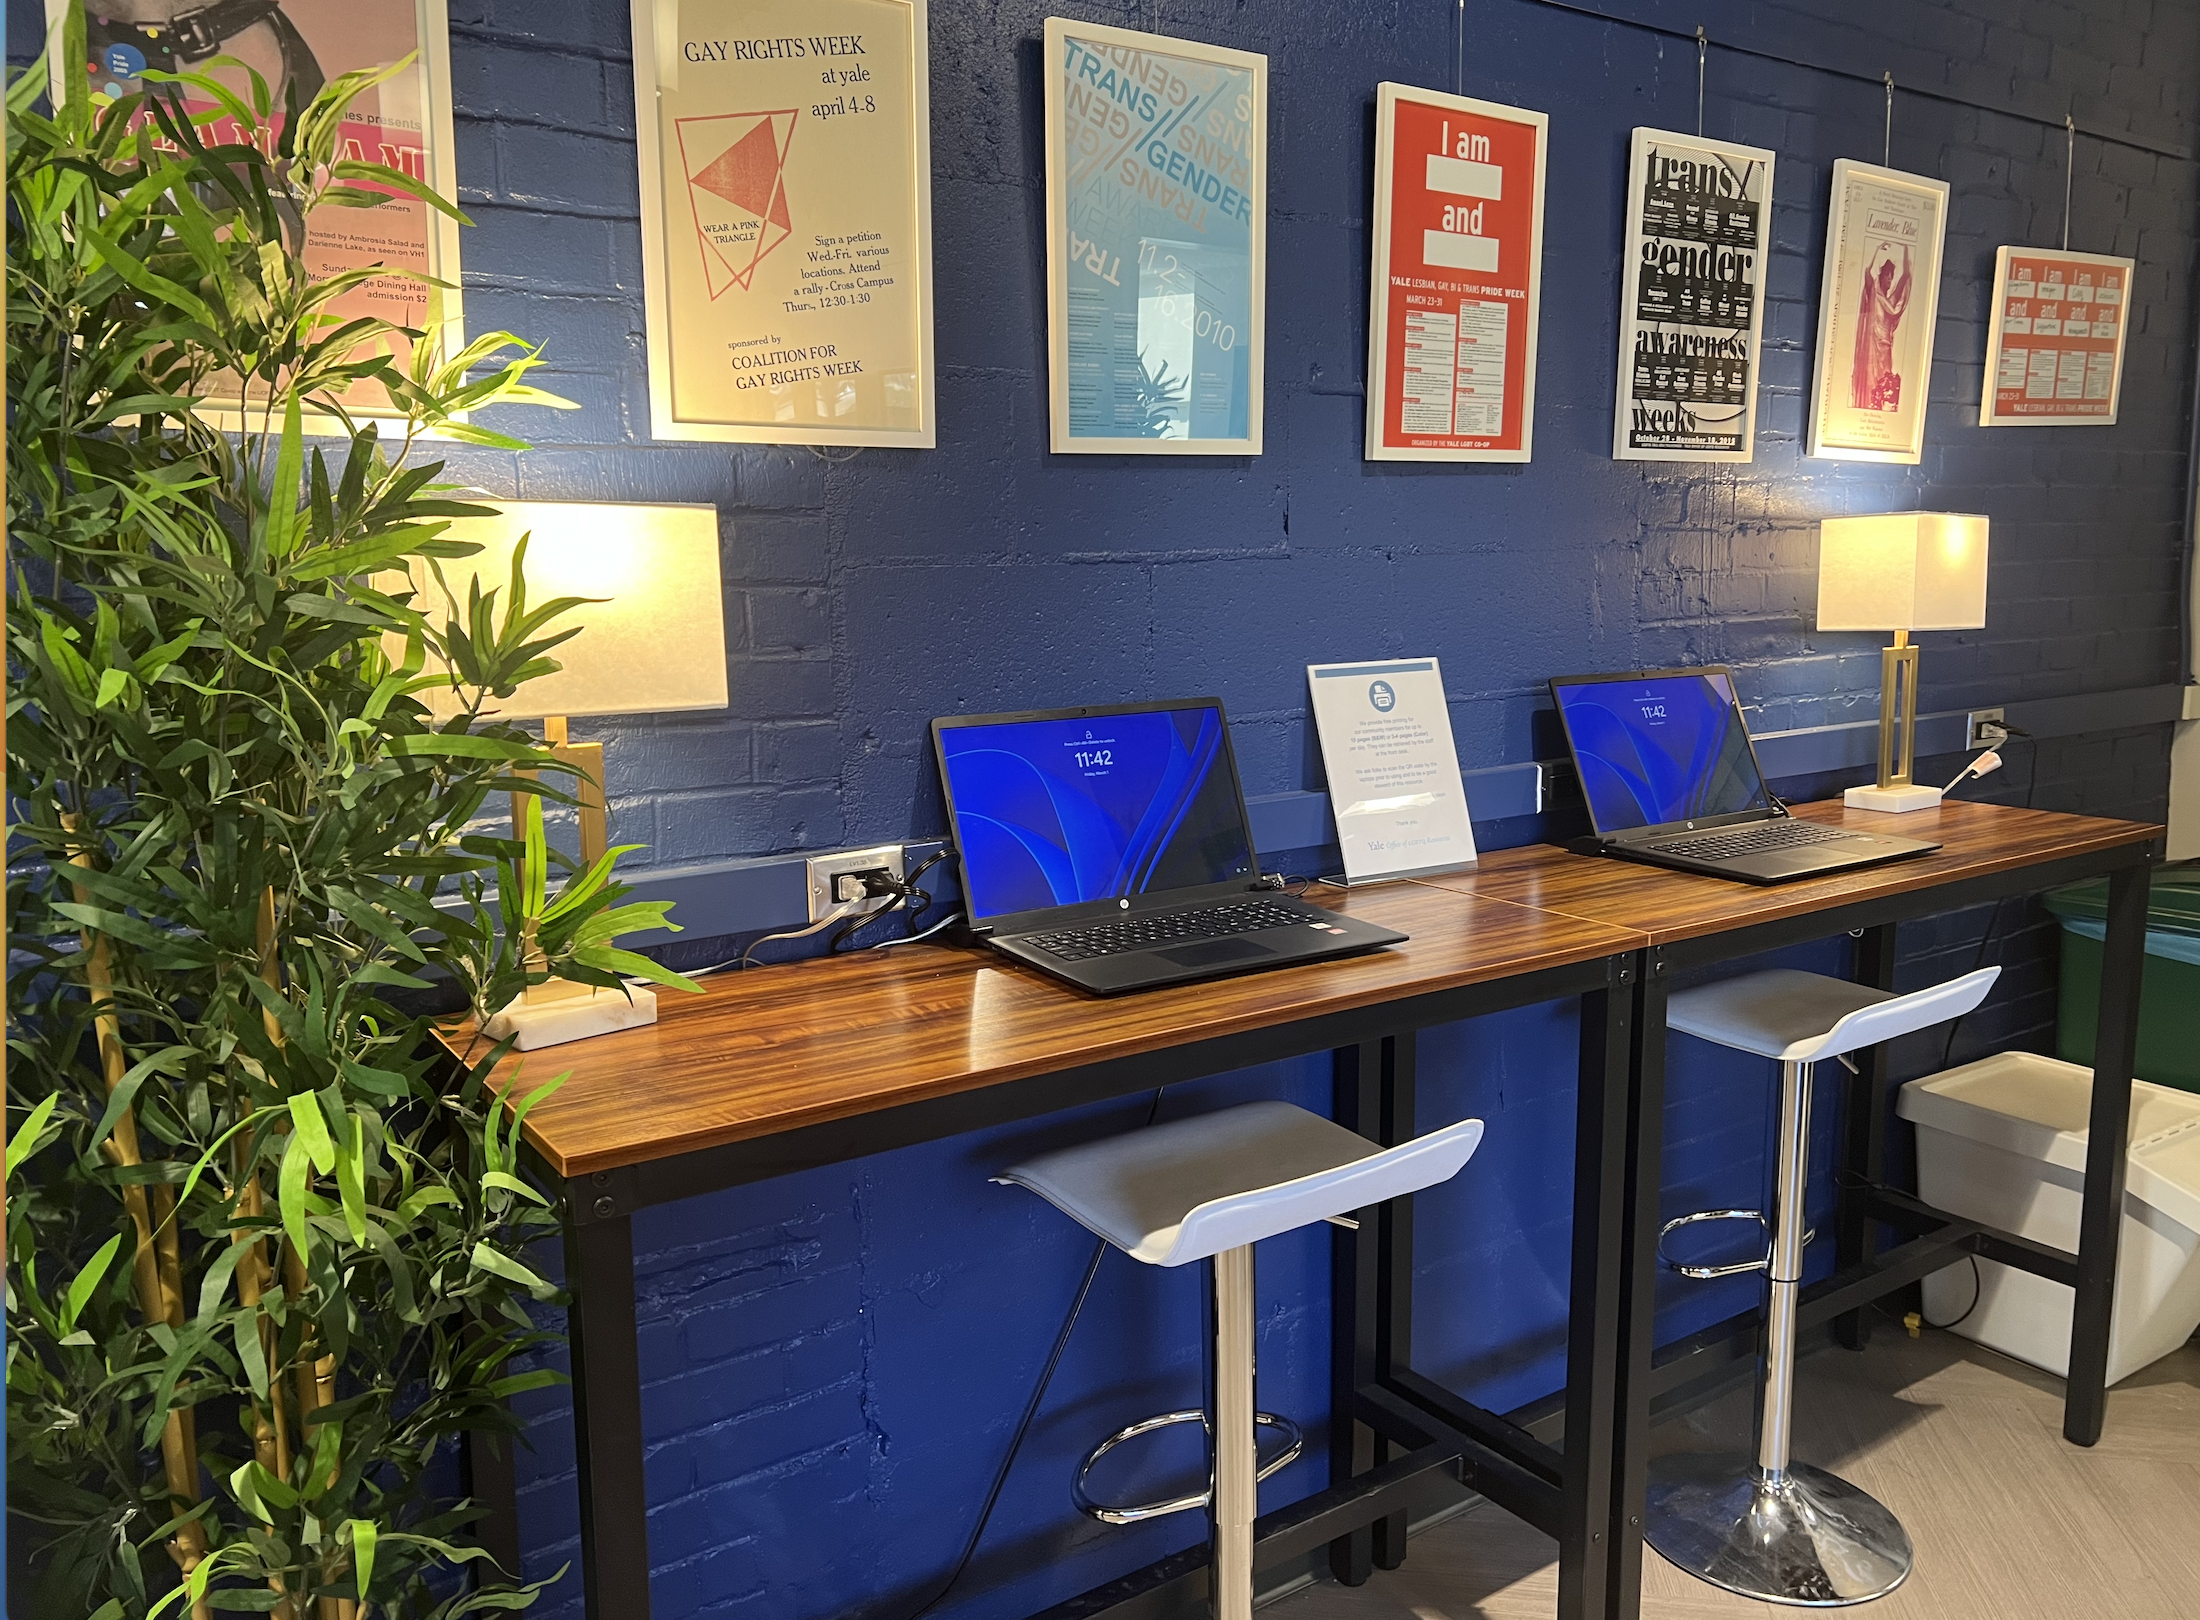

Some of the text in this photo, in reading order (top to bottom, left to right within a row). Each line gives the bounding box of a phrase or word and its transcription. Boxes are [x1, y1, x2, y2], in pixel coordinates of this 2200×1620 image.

[684, 35, 866, 62] GAY RIGHTS WEEK
[822, 63, 870, 86] at yale
[812, 95, 875, 120] april 4-8
[368, 115, 421, 130] presents
[1442, 120, 1490, 163] I am
[1442, 201, 1483, 235] and
[703, 221, 760, 233] WEAR A PINK
[308, 240, 342, 249] Darienne
[345, 244, 365, 252] Lake,
[309, 230, 336, 239] hosted
[338, 233, 347, 241] by
[349, 235, 386, 245] Ambrosia
[714, 233, 756, 244] TRIANGLE
[815, 235, 836, 246] Sign
[847, 231, 882, 245] petition
[856, 246, 889, 258] various
[1641, 237, 1753, 285] gender
[801, 261, 880, 280] locations. Attend
[2012, 263, 2031, 281] I am
[2044, 266, 2062, 283] I am
[2074, 269, 2091, 286] I am
[377, 280, 407, 291] Dining
[409, 283, 427, 292] Hall
[802, 282, 823, 295] rally
[830, 280, 854, 291] Cross
[857, 276, 894, 290] Campus
[1391, 276, 1525, 299] YALE LESBIAN, GAY, BI & TRANS PRIDE WEEK
[367, 291, 427, 303] admission $2
[819, 293, 870, 308] 12:30-1:30
[1406, 294, 1426, 305] MARCH
[2010, 300, 2027, 316] and
[2041, 301, 2058, 318] and
[2071, 304, 2087, 320] and
[2099, 306, 2114, 322] and
[728, 335, 781, 350] sponsored by
[1635, 329, 1747, 360] awareness
[732, 344, 837, 370] COALITION FOR
[736, 360, 863, 389] GAY RIGHTS WEEK
[1632, 403, 1696, 432] weeks
[1641, 705, 1666, 718] 11:42
[1075, 750, 1113, 768] 11:42
[1367, 840, 1384, 851] Yale
